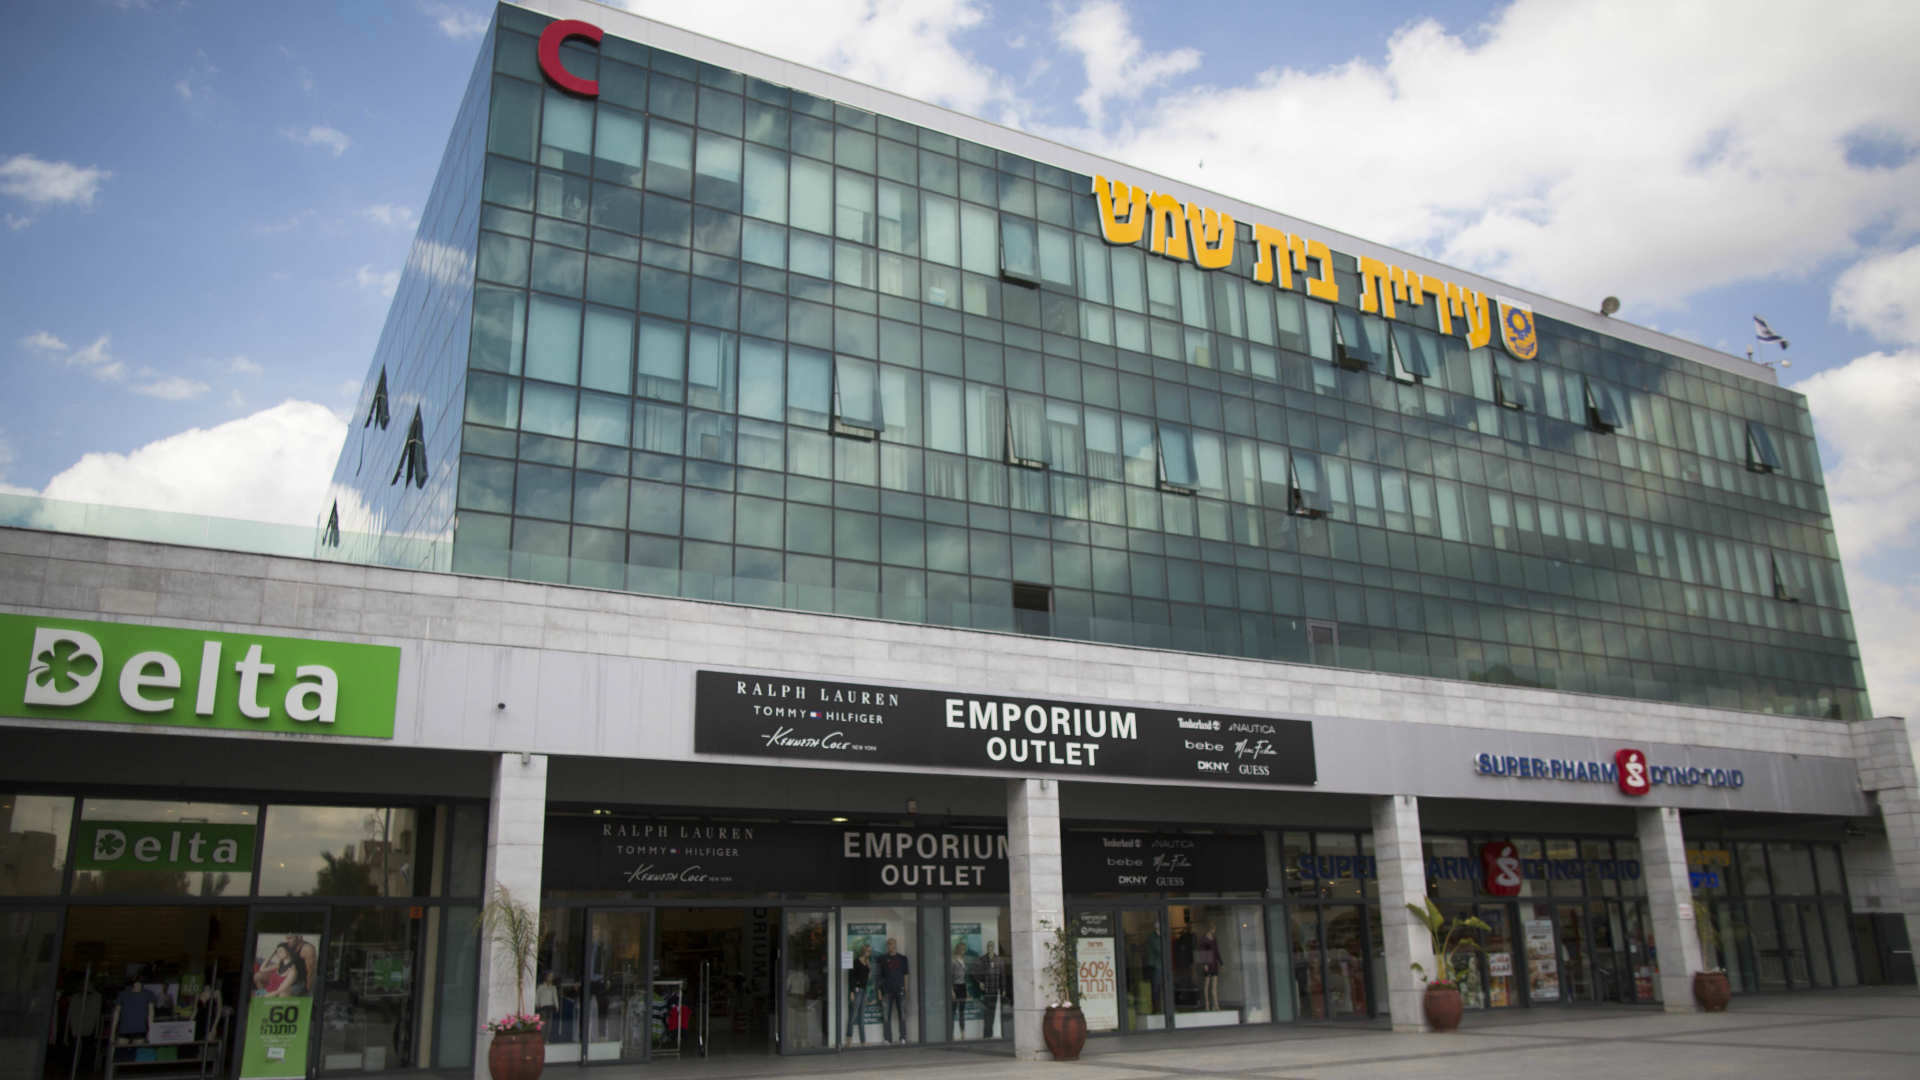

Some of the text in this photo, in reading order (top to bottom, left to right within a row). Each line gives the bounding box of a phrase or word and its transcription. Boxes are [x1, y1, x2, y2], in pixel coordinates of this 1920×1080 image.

[537, 19, 604, 98] C
[1092, 174, 1491, 350] עיריית בית שמש
[24, 627, 339, 724] Delta
[736, 681, 899, 706] RALPH LAUREN
[753, 705, 883, 724] TOMMY HILFIGER
[945, 698, 1138, 740] EMPORIUM
[1229, 723, 1276, 734] NAUTICA
[986, 736, 1100, 766] OUTLET
[1185, 740, 1224, 751] bebe
[1197, 760, 1270, 775] DKNY GUESS
[603, 824, 753, 840] RALPH LAUREN
[93, 828, 238, 863] Delta
[617, 845, 739, 857] TOMMY HILFIGER
[1107, 857, 1143, 866] bebe
[881, 864, 986, 886] OUTLET
[1118, 875, 1184, 887] DKNY GUESS
[1080, 961, 1113, 978] 60%
[1080, 978, 1114, 992] הנחה
[270, 1005, 298, 1023] 60
